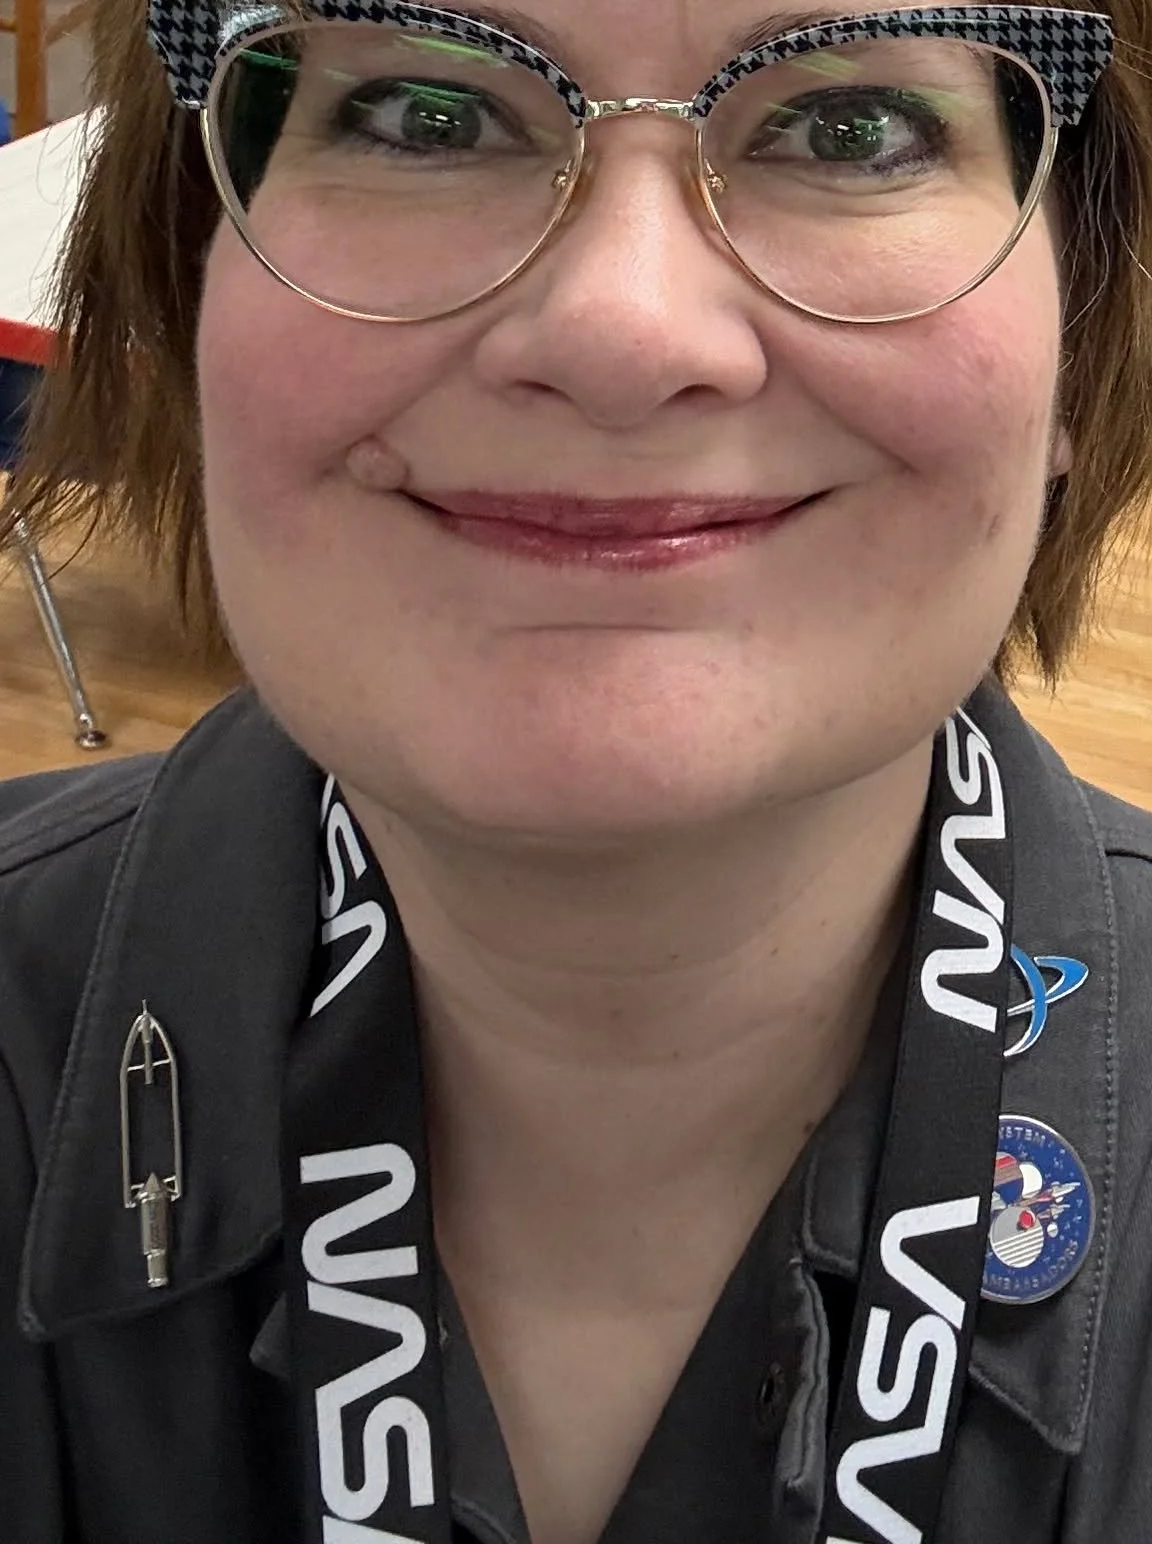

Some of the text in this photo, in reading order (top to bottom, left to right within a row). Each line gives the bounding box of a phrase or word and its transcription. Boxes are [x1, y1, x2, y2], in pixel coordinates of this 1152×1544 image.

[920, 706, 1006, 1033] NAS
[998, 1126, 1046, 1148] YSTEM
[299, 1142, 434, 1544] NAS
[826, 1195, 981, 1544] ASA
